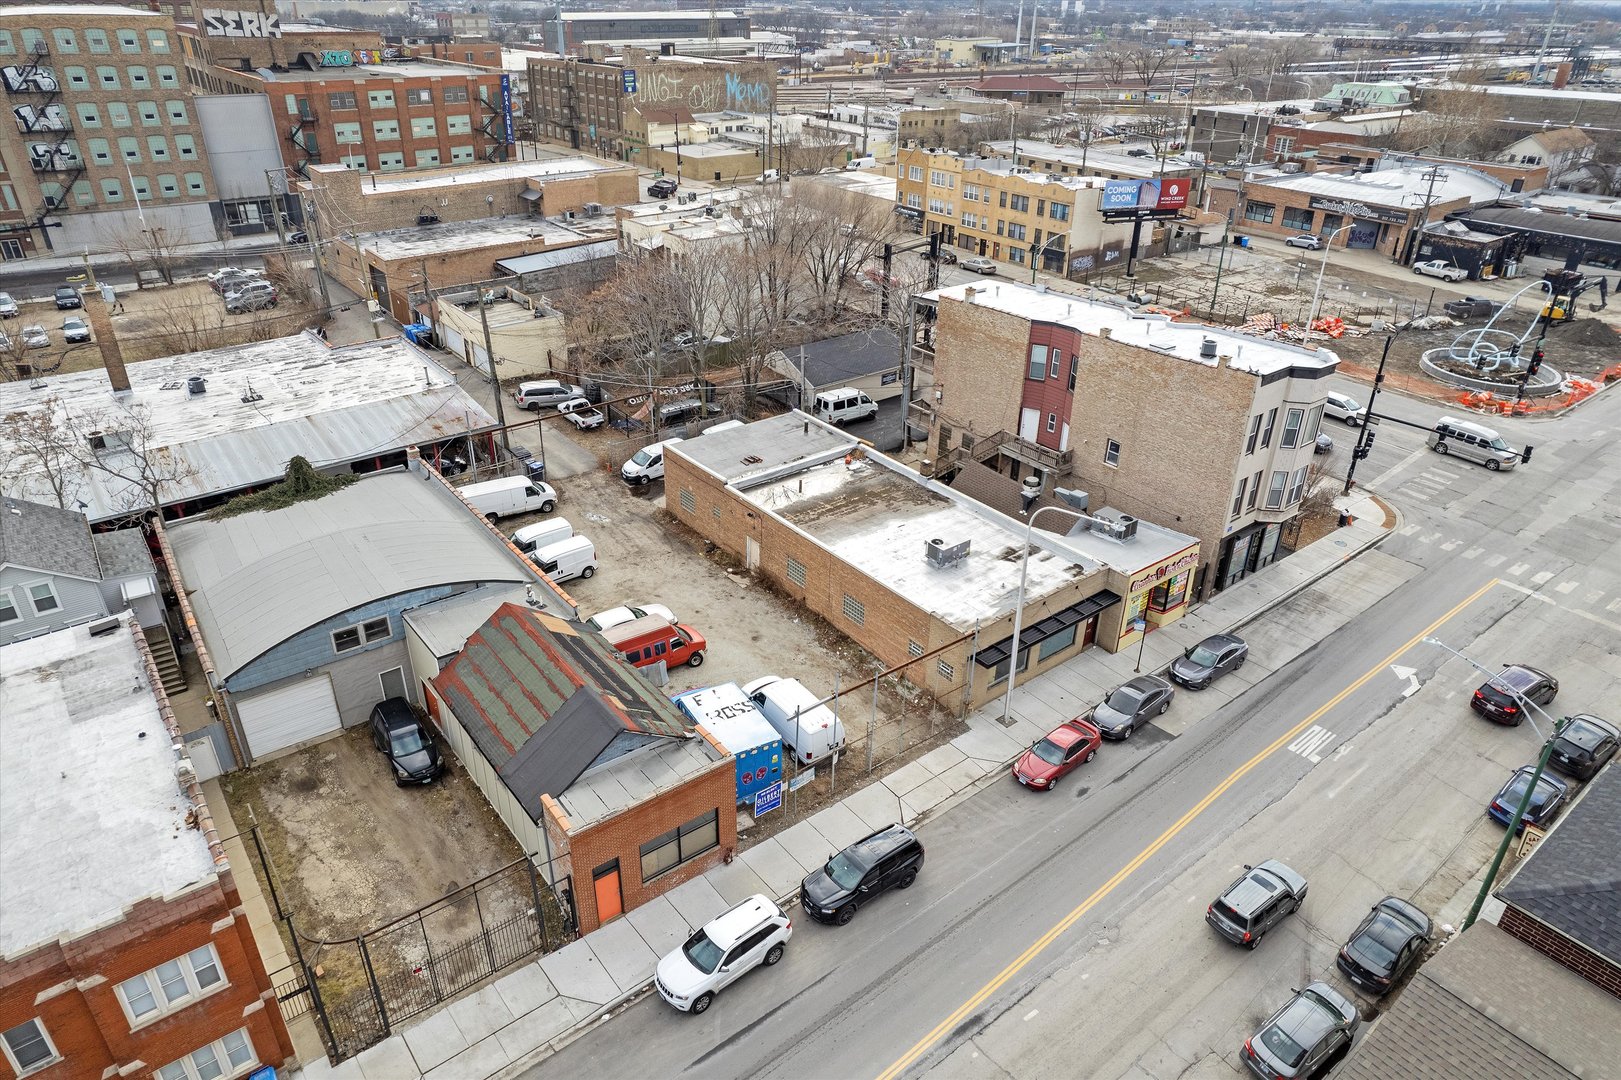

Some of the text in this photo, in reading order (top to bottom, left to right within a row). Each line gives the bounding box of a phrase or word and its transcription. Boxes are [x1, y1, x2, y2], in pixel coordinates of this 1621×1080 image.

[202, 8, 282, 39] SERK
[1107, 185, 1137, 194] COMING
[1110, 194, 1132, 202] SOON
